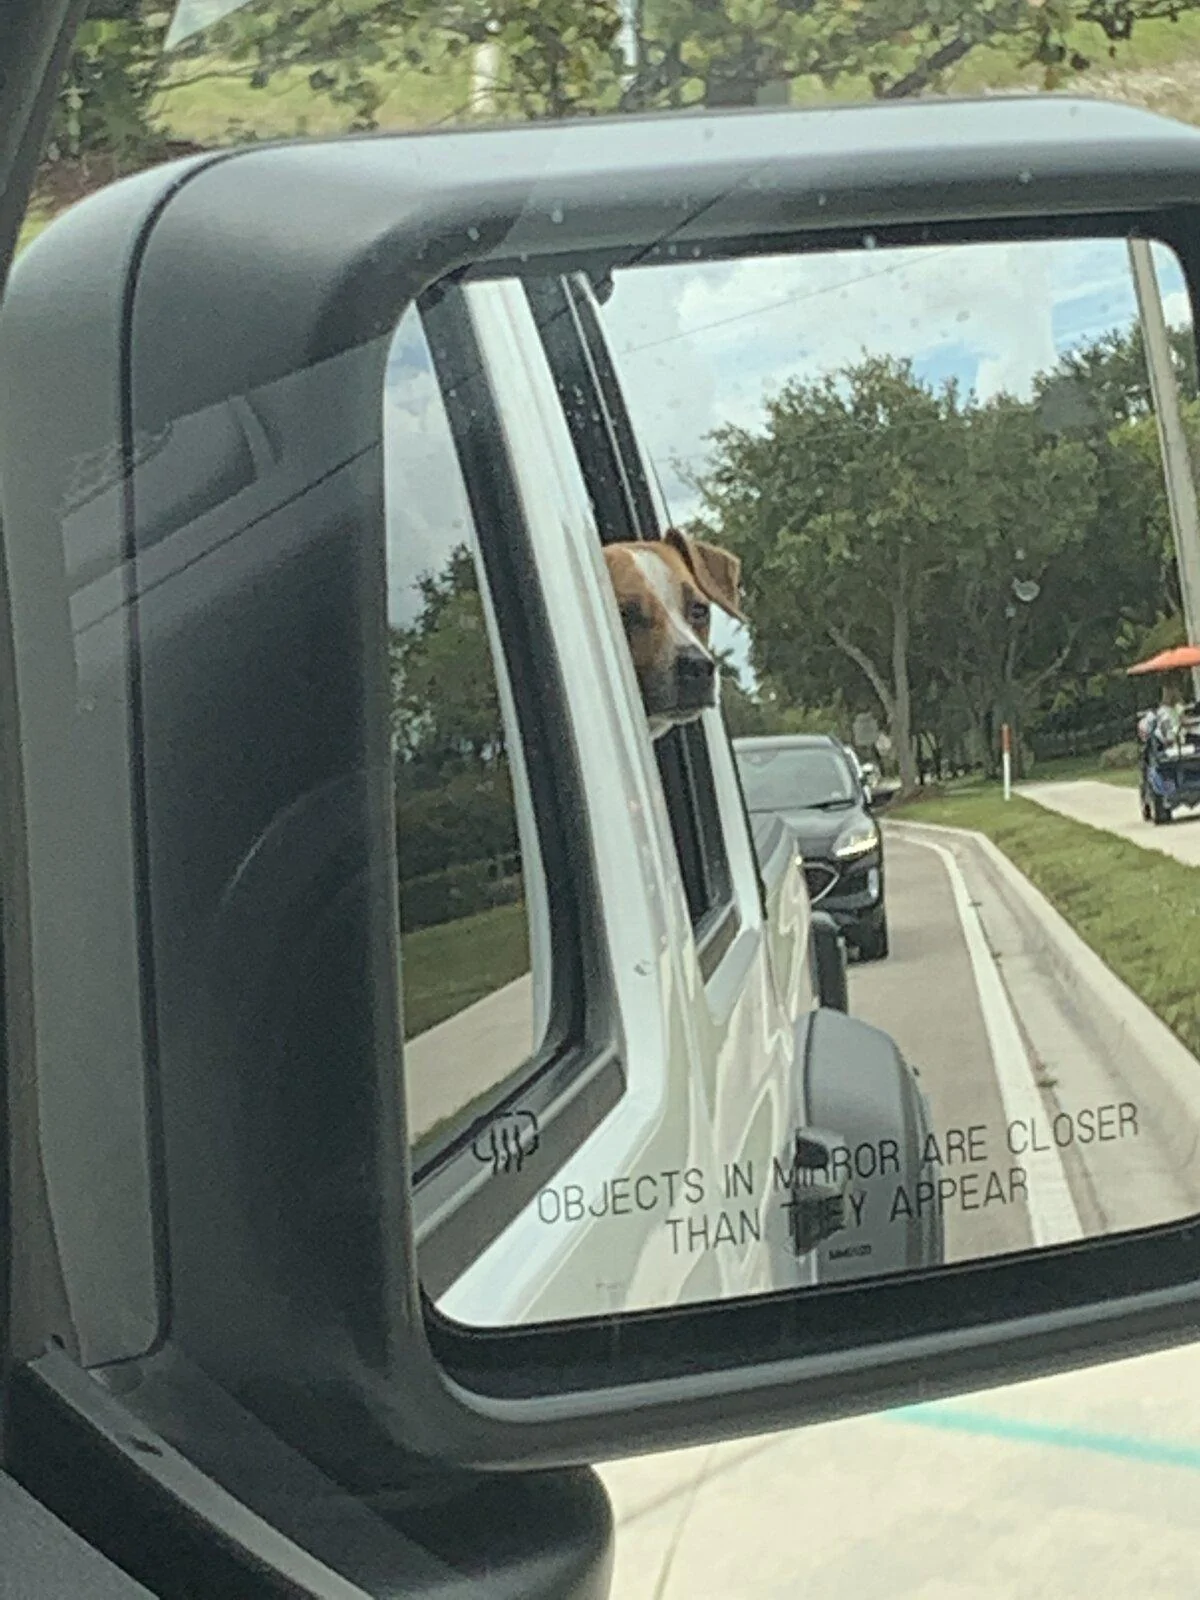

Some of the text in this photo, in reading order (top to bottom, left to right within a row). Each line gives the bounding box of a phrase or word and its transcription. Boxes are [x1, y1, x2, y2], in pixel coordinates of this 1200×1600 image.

[538, 1168, 705, 1224] OBJECTS
[723, 1160, 753, 1199] IN
[923, 1125, 988, 1166] ARE
[1007, 1102, 1139, 1155] CLOSER
[665, 1168, 1028, 1254] THAN TEY APPEAR
